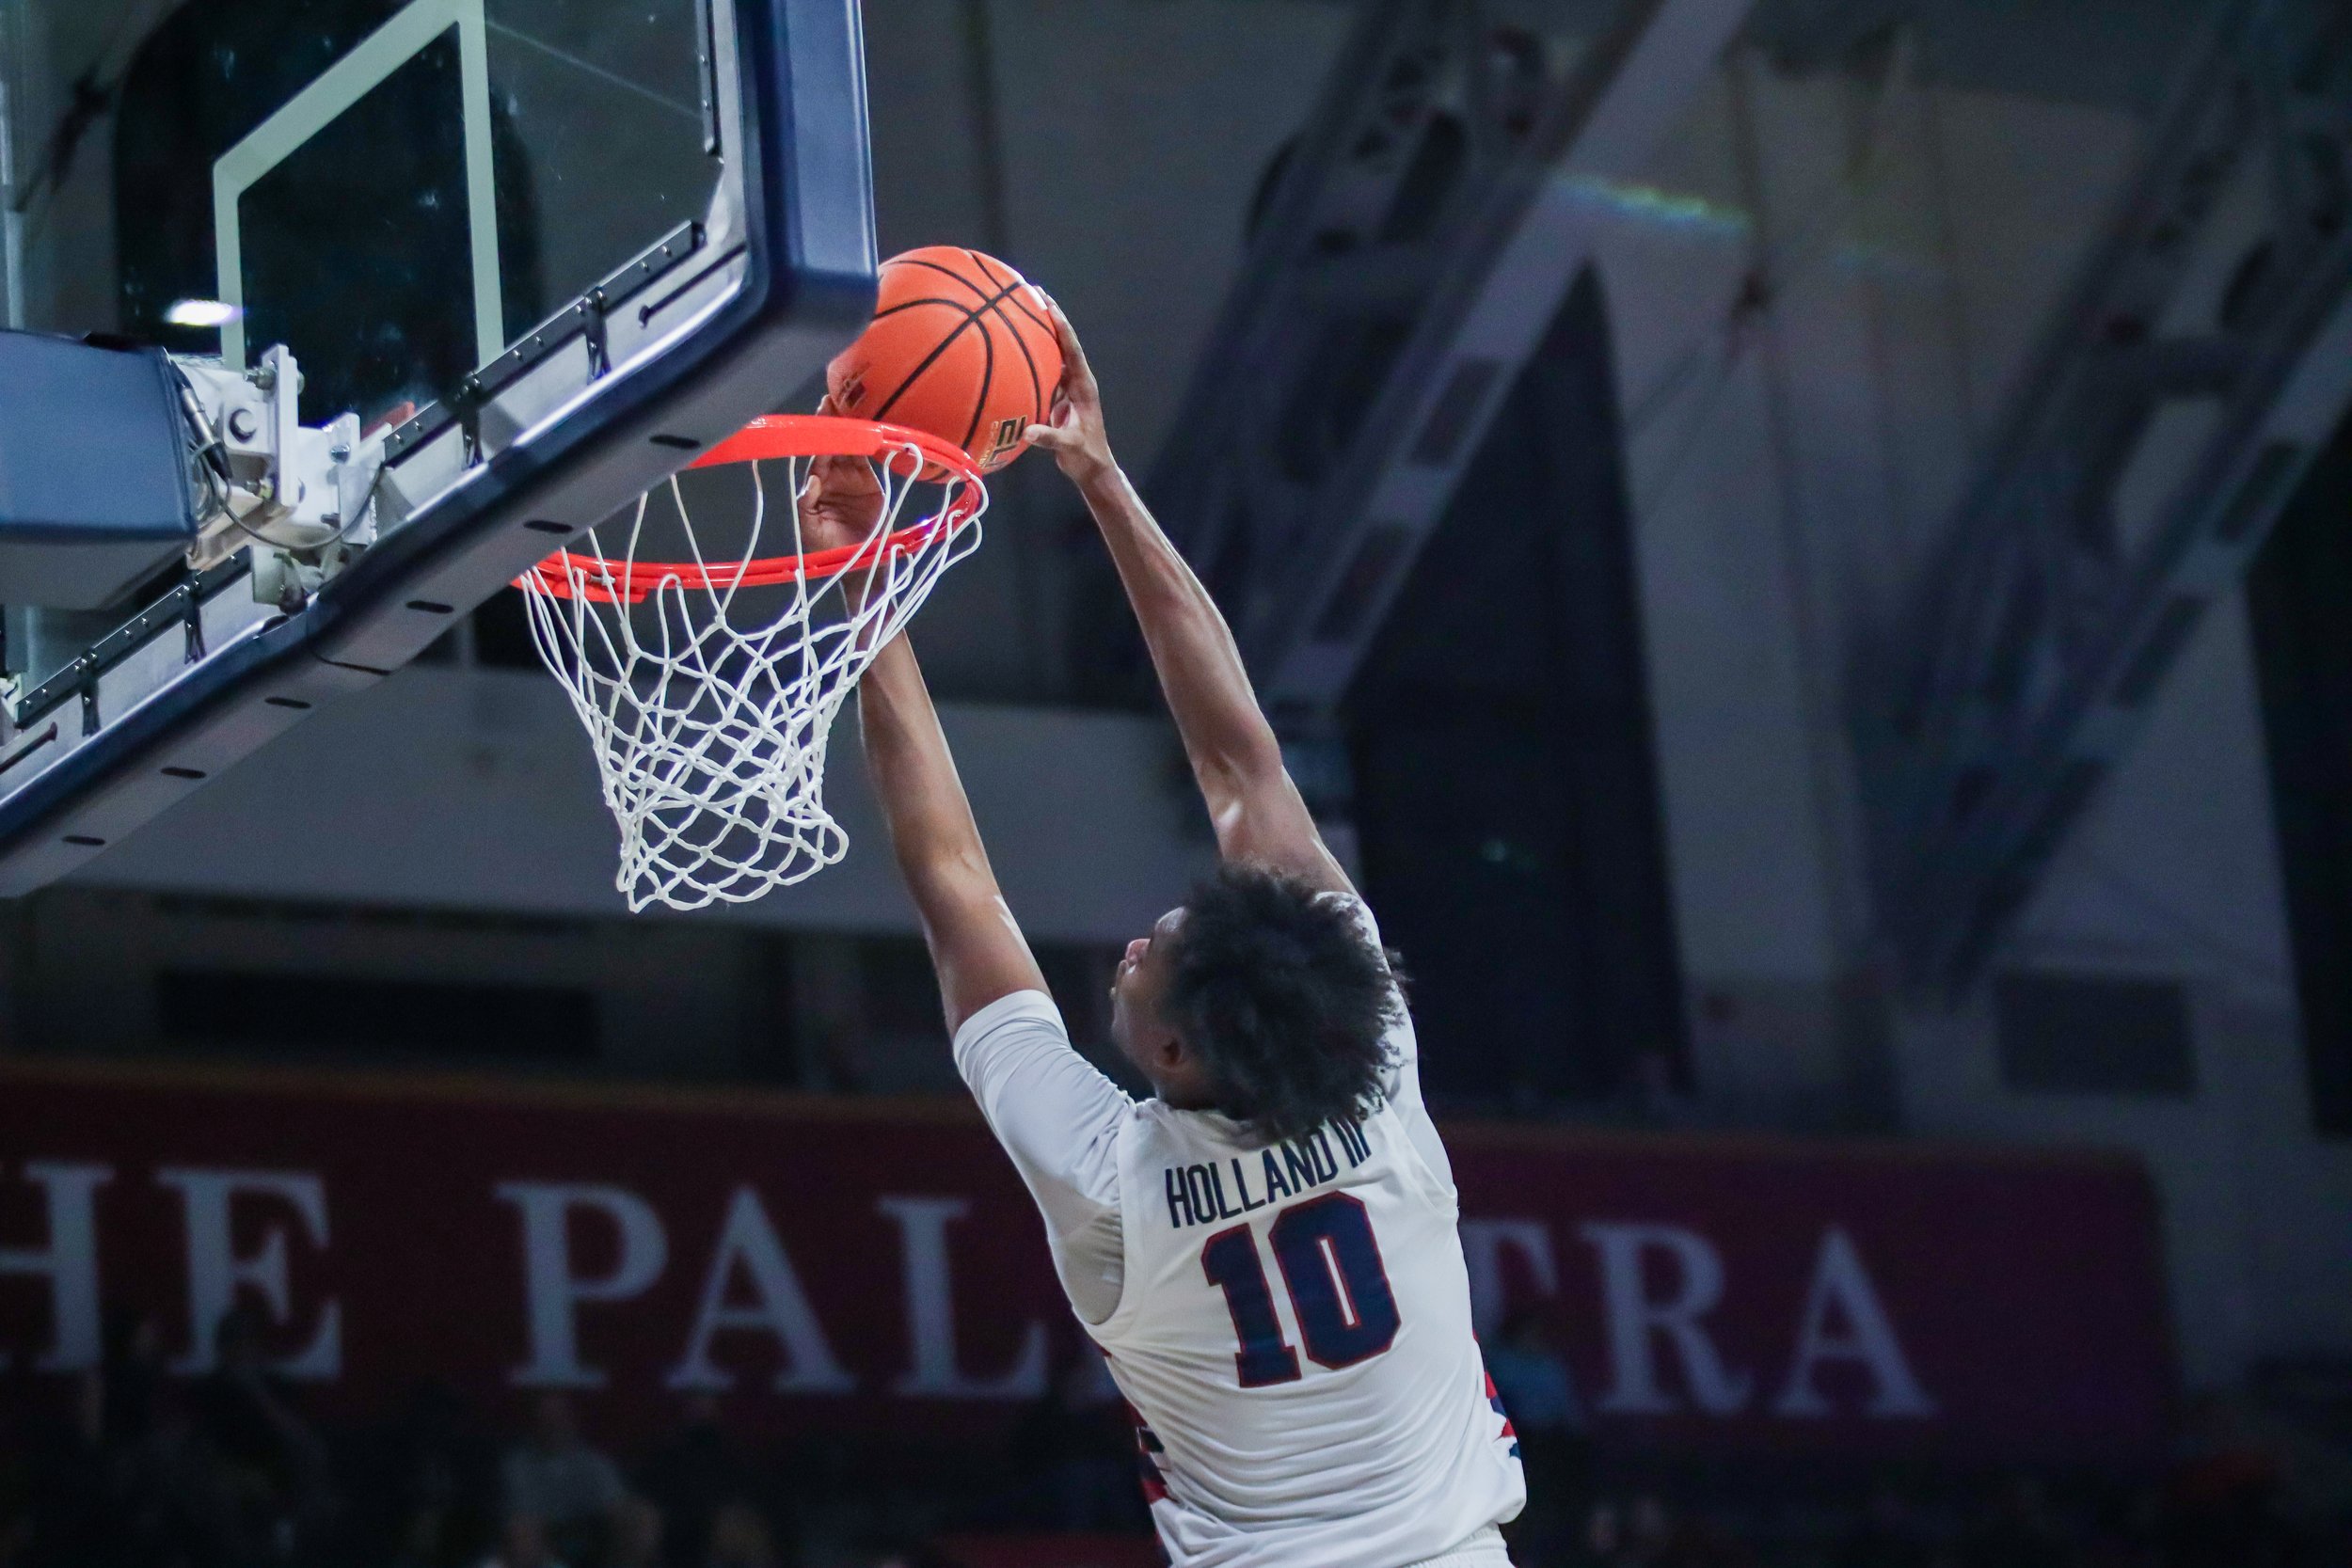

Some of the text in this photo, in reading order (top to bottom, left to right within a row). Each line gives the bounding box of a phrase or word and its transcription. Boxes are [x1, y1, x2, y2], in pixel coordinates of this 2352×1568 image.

[1165, 1116, 1373, 1228] HOLLAND III
[1201, 1190, 1402, 1389] 10
